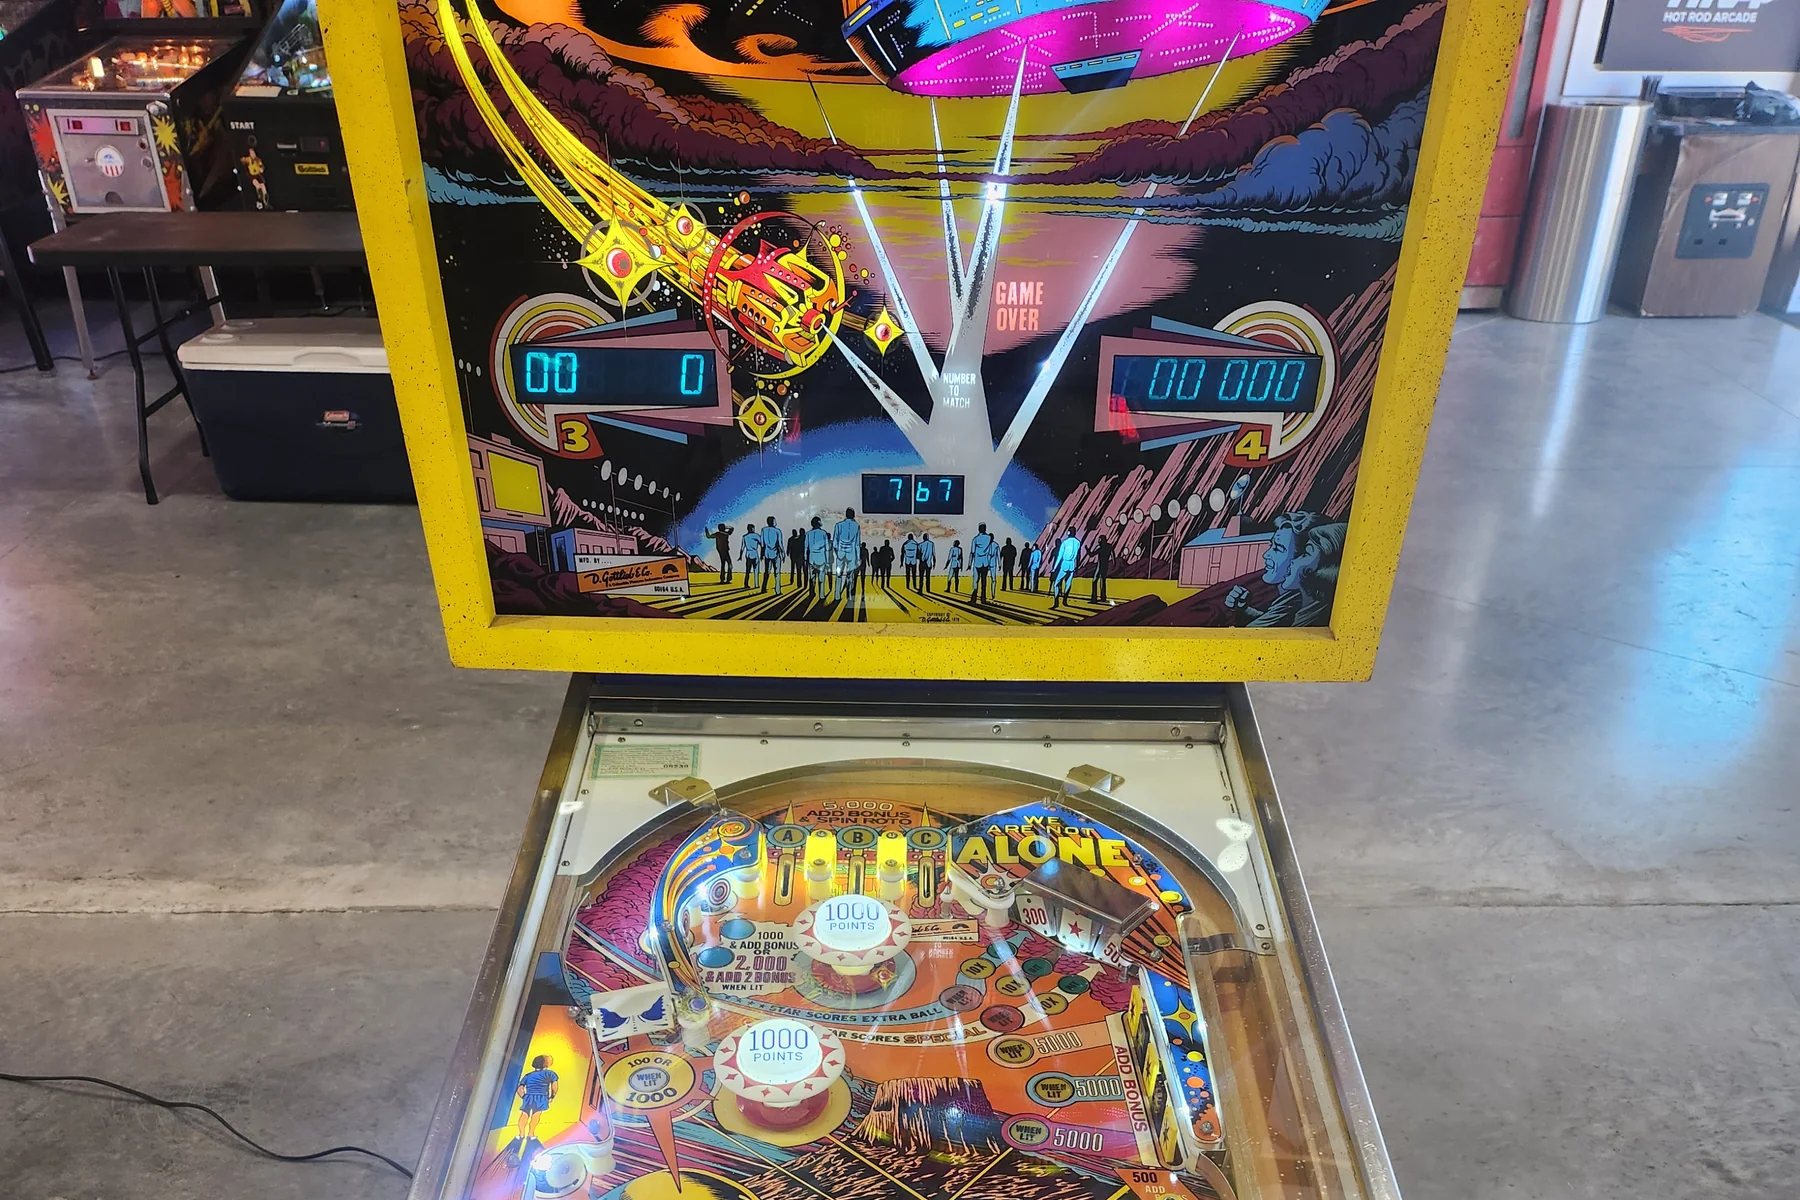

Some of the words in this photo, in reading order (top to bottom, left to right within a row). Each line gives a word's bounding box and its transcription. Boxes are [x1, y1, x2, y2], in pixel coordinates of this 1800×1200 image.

[1663, 11, 1687, 22] HOT
[1687, 12, 1712, 22] ROD
[1712, 12, 1758, 23] ARCADE
[230, 121, 255, 130] START
[996, 281, 1044, 305] GAME
[996, 307, 1040, 331] OVER
[943, 373, 976, 385] NUMBER
[949, 385, 960, 396] TO
[943, 397, 970, 409] MATCH
[560, 420, 590, 452] 3
[1235, 430, 1267, 460] 4
[822, 800, 894, 811] 5,000
[848, 810, 911, 818] BONUS
[1023, 815, 1060, 825] WE
[817, 816, 858, 824] SPIN
[863, 817, 912, 825] ROTO
[782, 828, 792, 842] A
[987, 824, 1033, 834] ARE
[1044, 825, 1094, 836] NOT
[852, 831, 864, 844] B
[920, 832, 932, 844] C
[956, 835, 1129, 867] ALONE
[825, 902, 880, 922] 1000
[1022, 907, 1046, 925] 300
[829, 922, 875, 931] POINTS
[758, 931, 783, 940] 1000
[729, 941, 737, 949] &
[740, 941, 761, 949] ADD
[763, 941, 799, 949] BONUS
[735, 955, 787, 971] 2,000
[965, 962, 986, 976] 10X
[769, 1005, 801, 1016] STAR
[806, 1011, 857, 1022] SCORES
[862, 1013, 906, 1023] EXTRA
[909, 1007, 943, 1021] BALL
[749, 1028, 809, 1051] 1000
[1033, 1030, 1083, 1058] 5000
[627, 1057, 651, 1068] 100
[653, 1057, 672, 1066] OR
[753, 1051, 804, 1062] POINTS
[636, 1072, 661, 1081] WHEN
[1040, 1083, 1068, 1092] WHEN
[1074, 1078, 1122, 1097] 5000
[1114, 1045, 1133, 1075] ADD
[1124, 1079, 1148, 1132] BONUS
[626, 1087, 678, 1103] 1000
[1046, 1090, 1062, 1099] LIT
[1015, 1125, 1042, 1135] WHEN
[1019, 1132, 1036, 1141] LIT
[1053, 1128, 1103, 1152] 5000
[1132, 1171, 1158, 1183] 500
[1145, 1185, 1166, 1194] ADD
